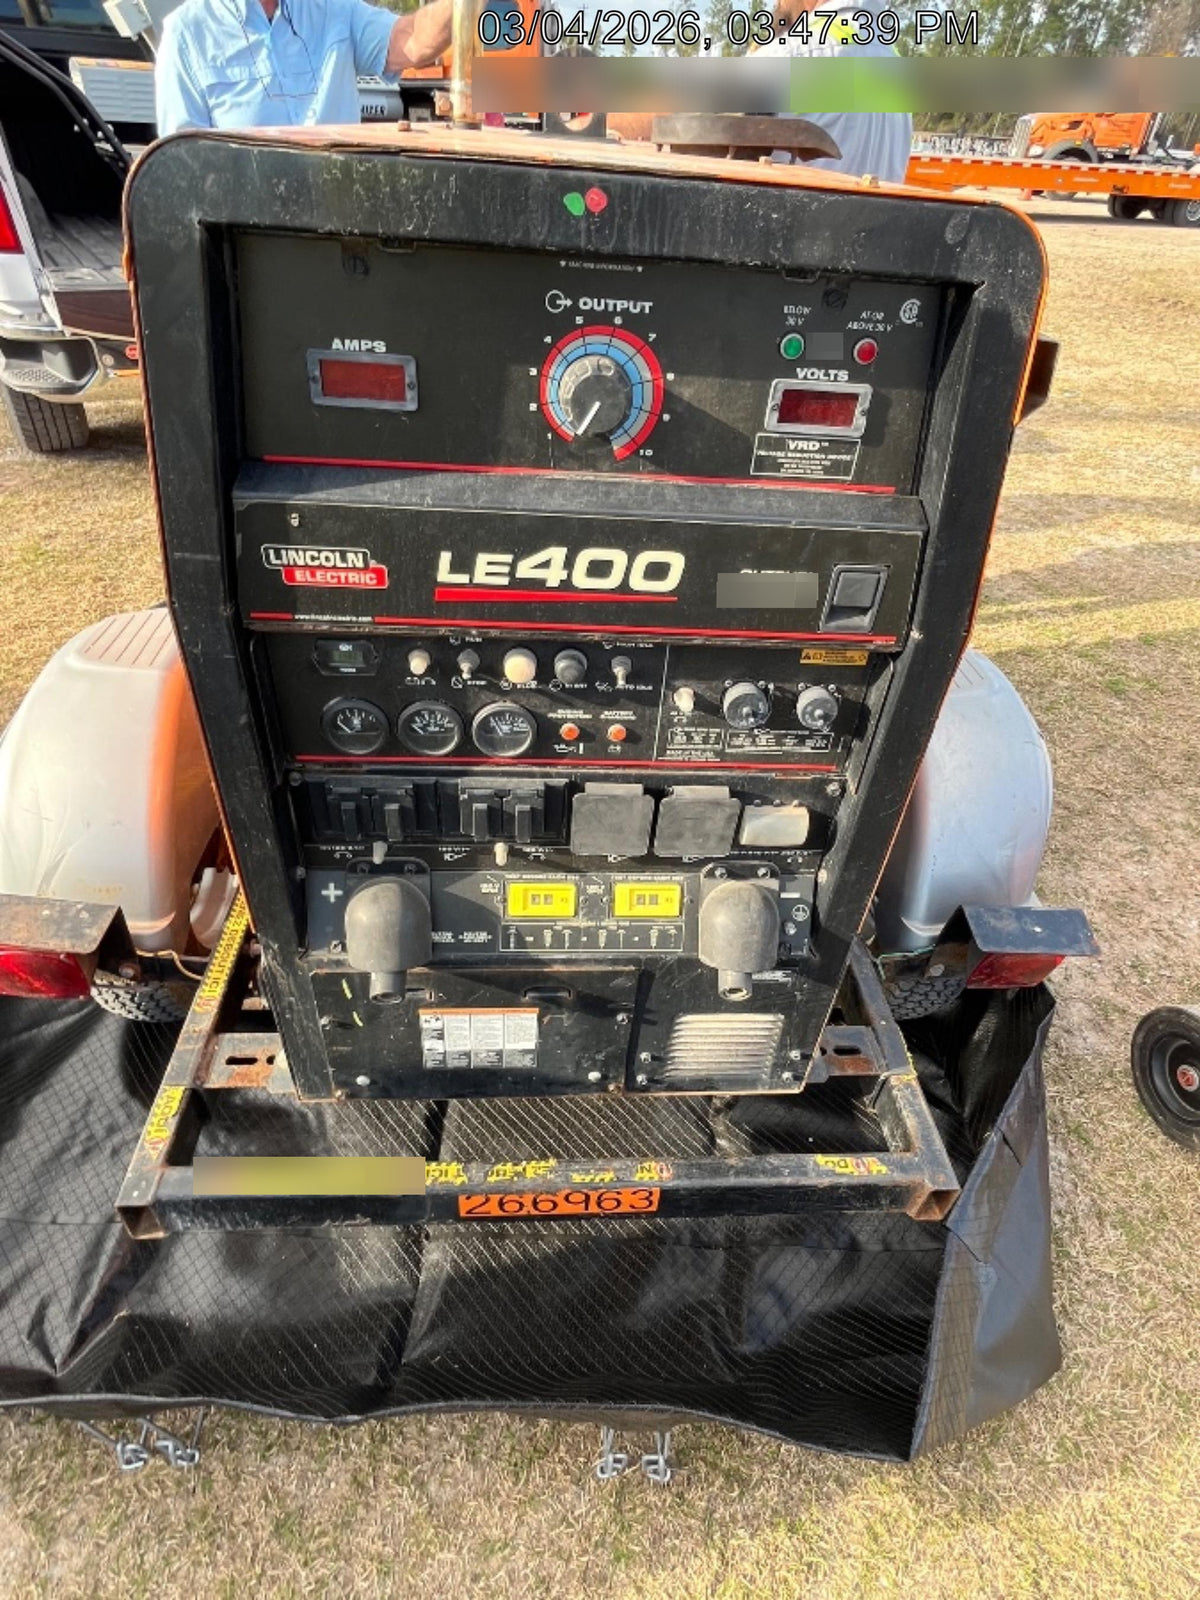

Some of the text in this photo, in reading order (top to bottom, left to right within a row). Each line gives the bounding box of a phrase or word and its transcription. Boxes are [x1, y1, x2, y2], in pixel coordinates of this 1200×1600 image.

[578, 297, 653, 314] OUTPUT
[575, 316, 583, 324] 5
[614, 316, 623, 325] 6
[543, 335, 552, 344] 4
[648, 333, 657, 342] 7
[331, 337, 387, 353] AMPS
[529, 367, 538, 376] 3
[795, 367, 849, 382] VOLTS
[666, 373, 675, 381] 8
[529, 403, 538, 412] 2
[662, 413, 671, 422] 9
[269, 549, 365, 568] LINCOLN
[436, 546, 685, 593] LE400
[294, 570, 377, 585] ELECTRIC
[465, 1189, 654, 1215] 266963
